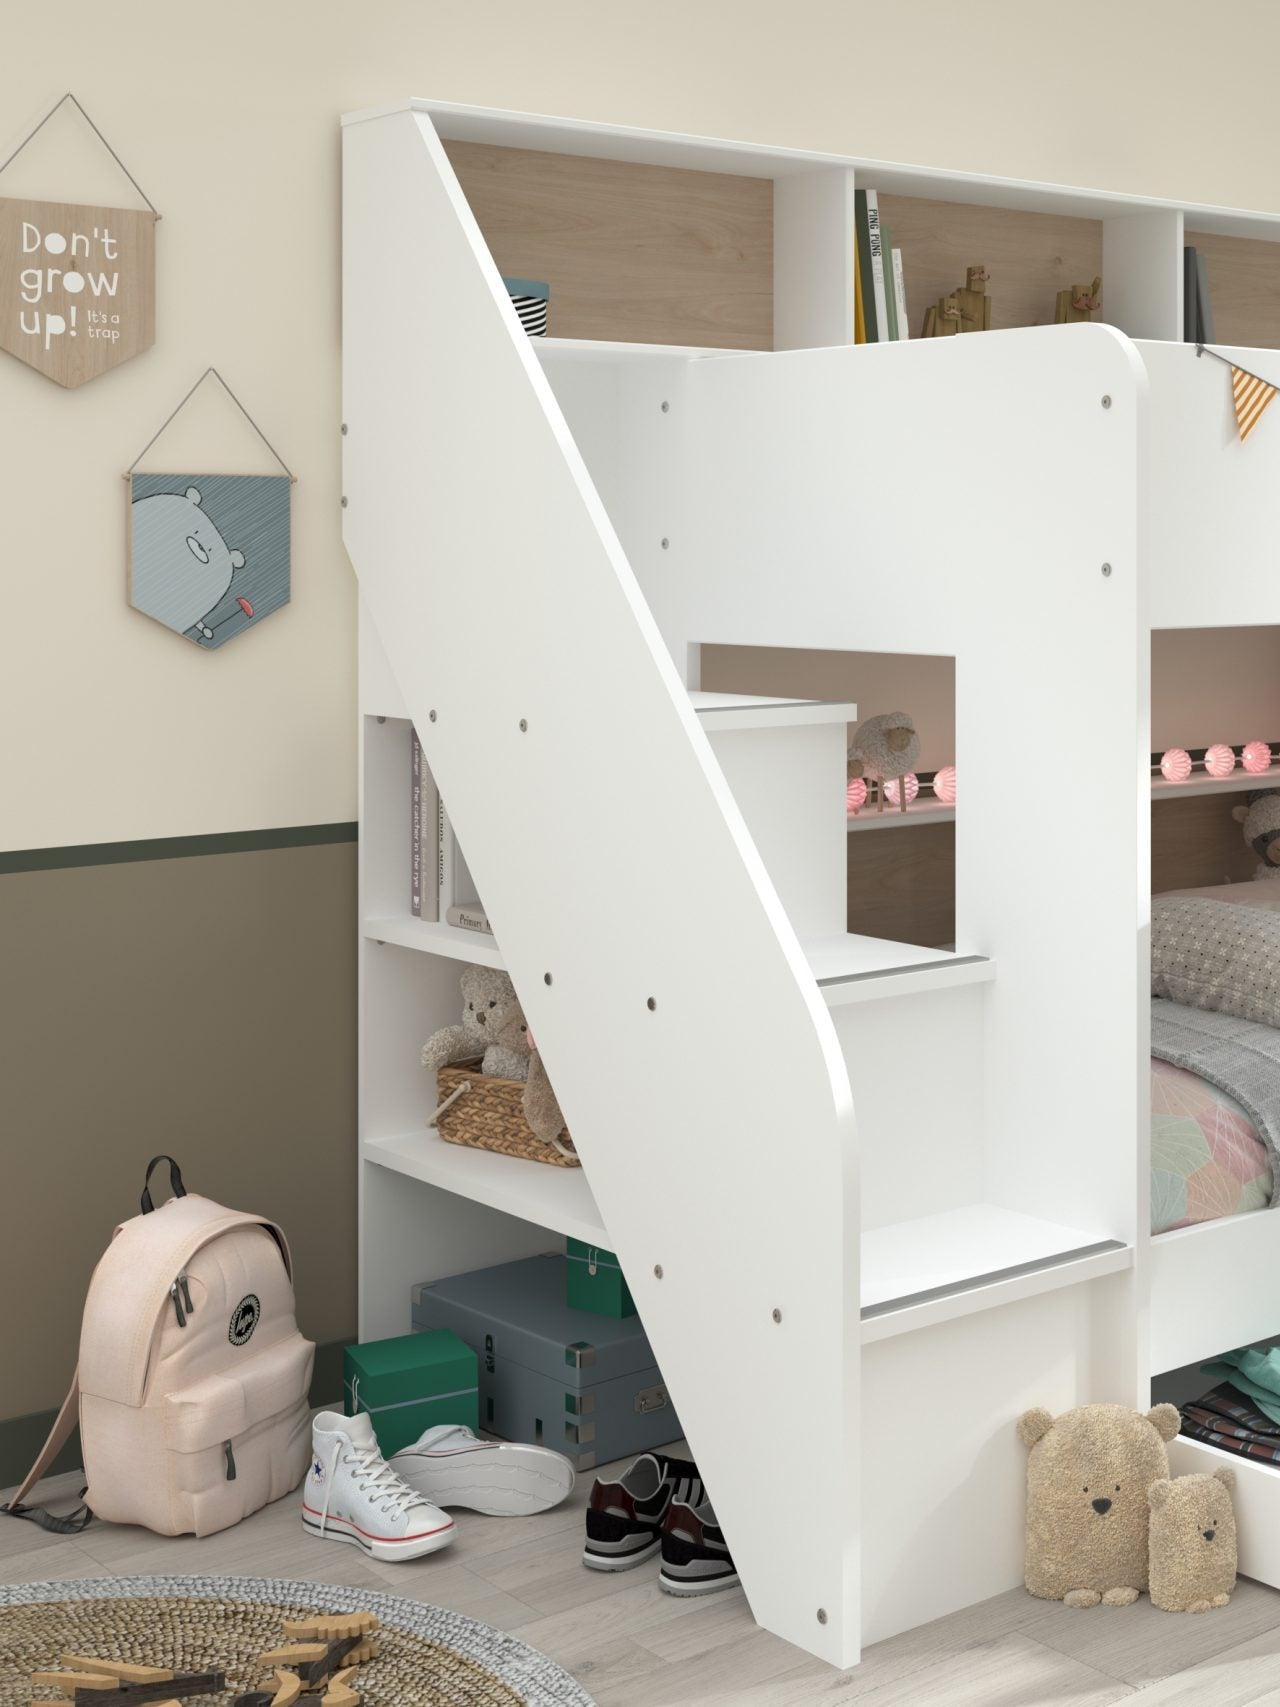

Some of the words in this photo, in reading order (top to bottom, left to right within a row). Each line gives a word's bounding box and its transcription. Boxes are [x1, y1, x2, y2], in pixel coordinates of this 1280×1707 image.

[868, 209, 879, 230] PING
[22, 221, 119, 260] Don't
[870, 234, 882, 257] PONG
[20, 267, 119, 303] grow
[20, 306, 77, 350] up!
[87, 310, 108, 324] It's
[110, 312, 120, 325] a
[88, 325, 121, 344] trap
[413, 843, 420, 852] in
[412, 872, 420, 888] rye
